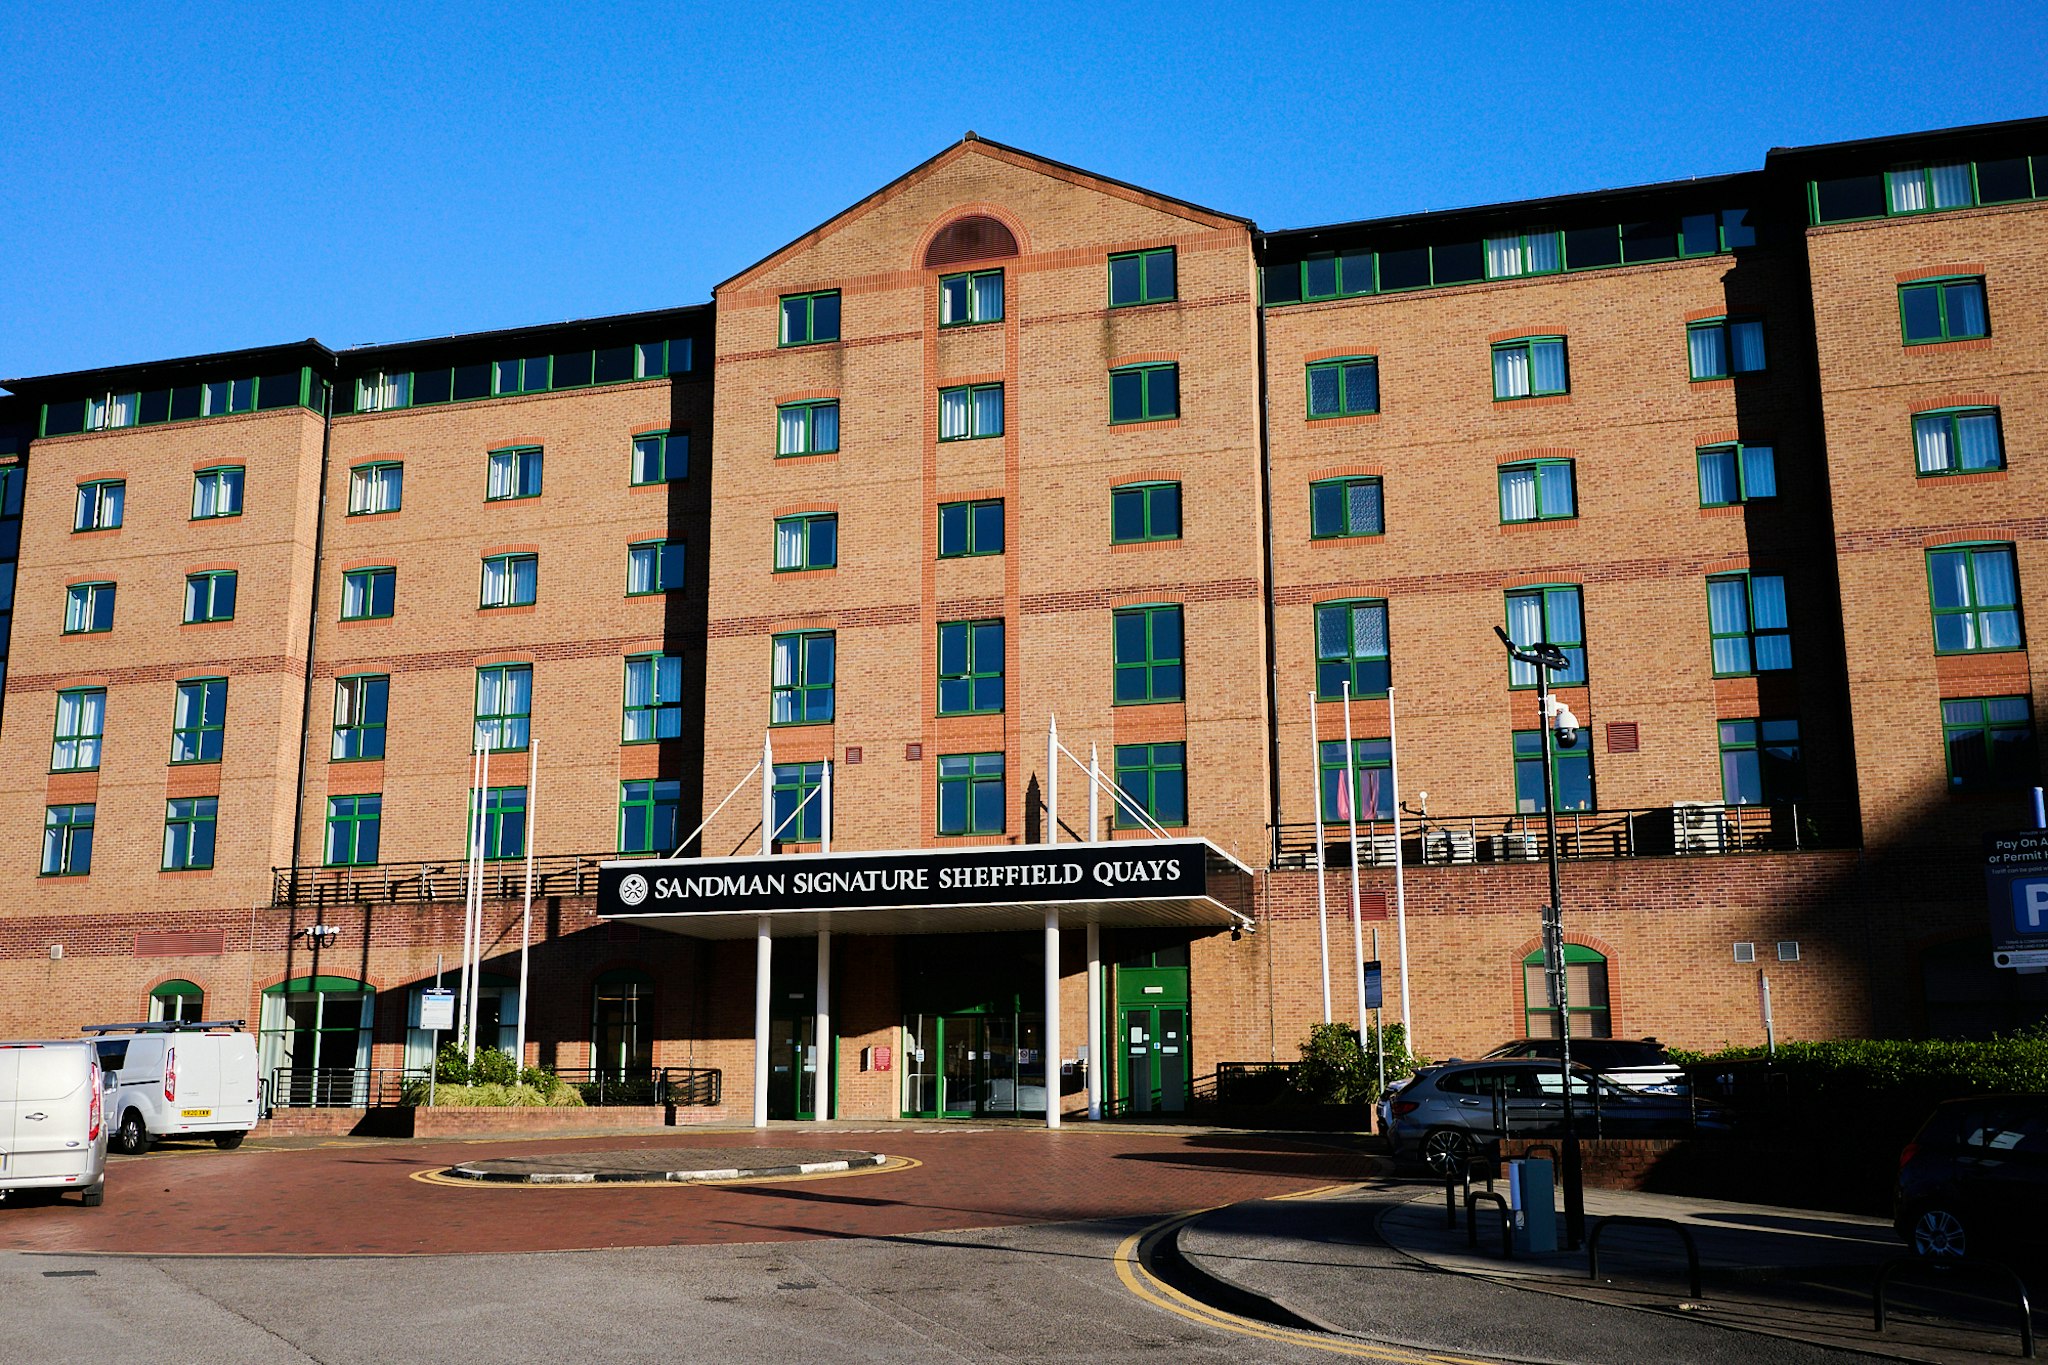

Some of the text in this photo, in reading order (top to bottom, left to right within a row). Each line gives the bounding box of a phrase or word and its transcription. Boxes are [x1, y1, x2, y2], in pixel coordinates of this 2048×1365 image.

[1988, 855, 2000, 863] or
[2003, 850, 2042, 862] Permit
[1996, 840, 2018, 851] Pay
[2020, 838, 2038, 848] On
[655, 859, 1181, 898] SANDMAN SIGNATURE SHEFFIELD QUAYS
[2025, 883, 2048, 926] P
